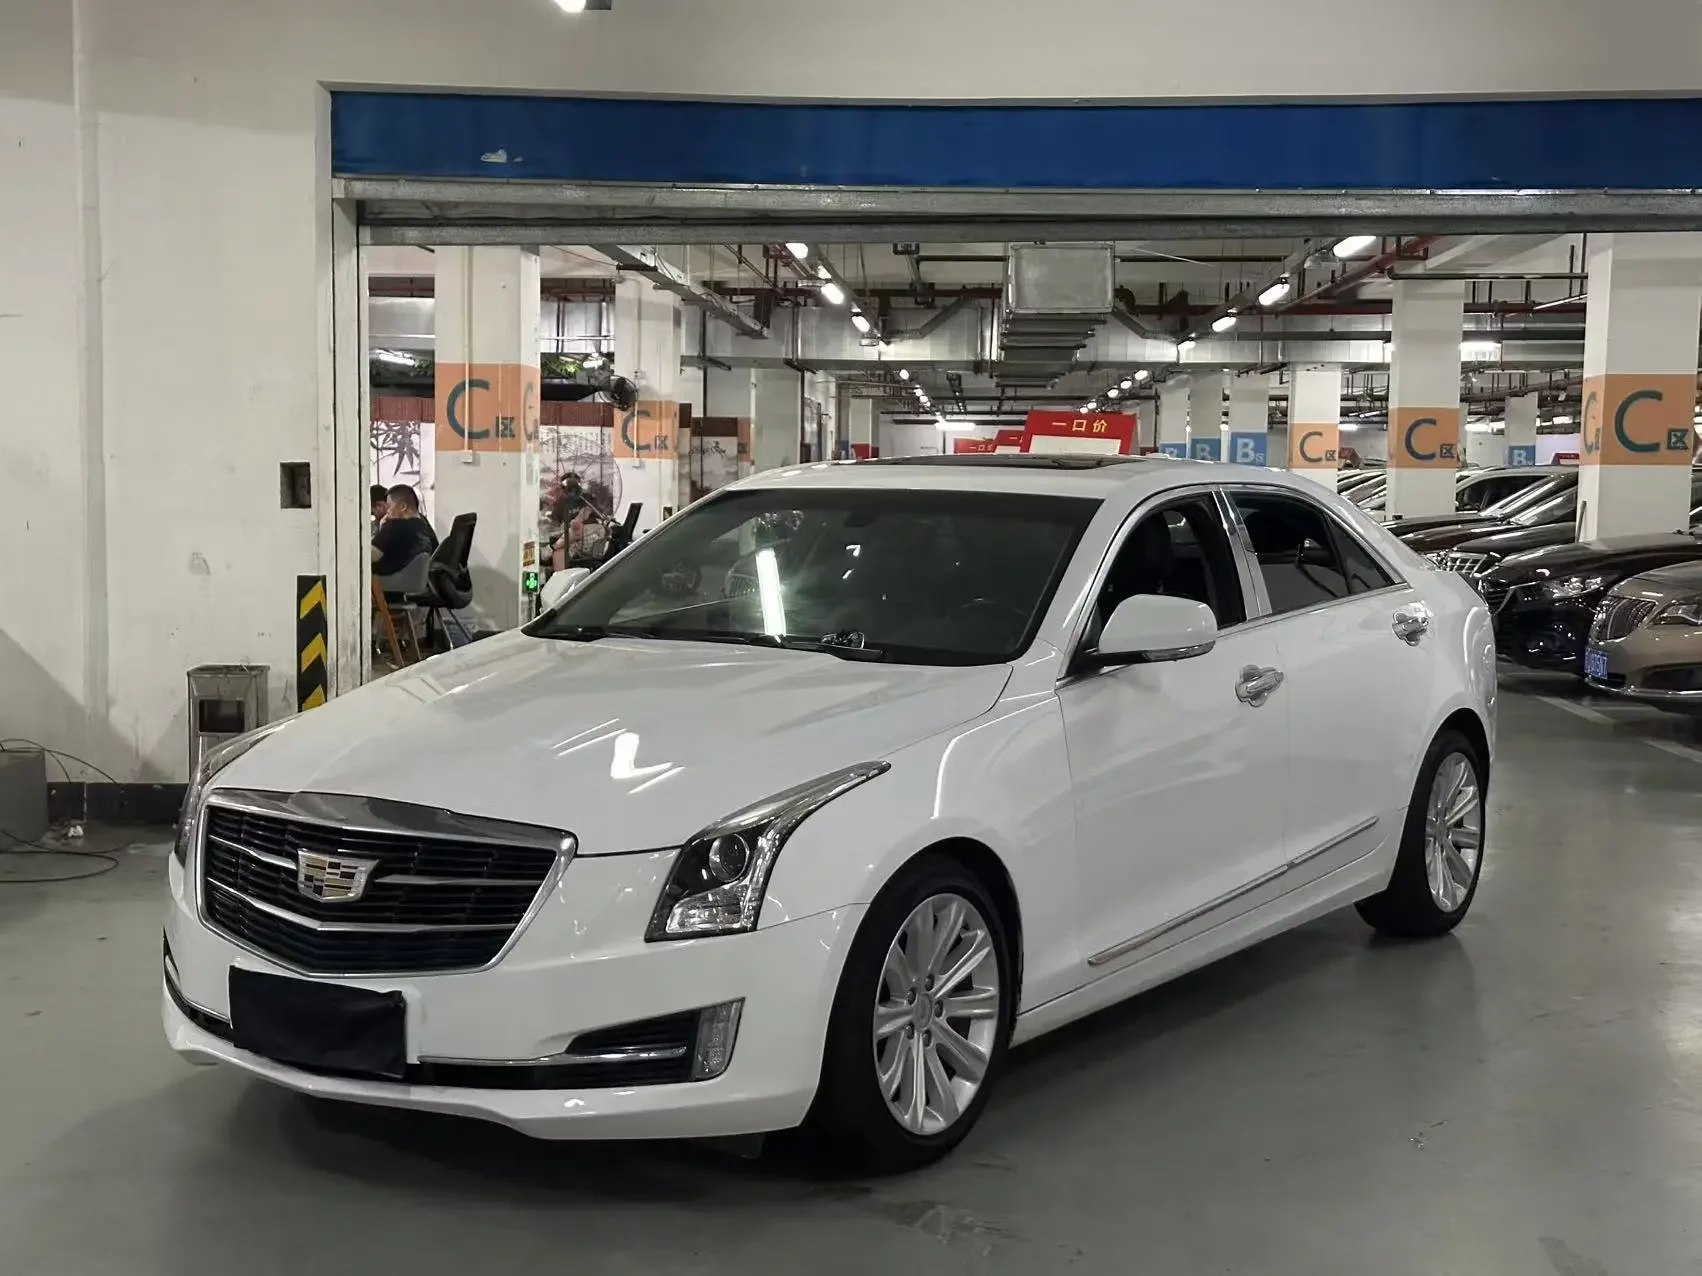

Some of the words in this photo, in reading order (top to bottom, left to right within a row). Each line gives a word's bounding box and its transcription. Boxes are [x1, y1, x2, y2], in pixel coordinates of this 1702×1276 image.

[1051, 419, 1108, 433] 一口价
[1615, 389, 1689, 453] C区
